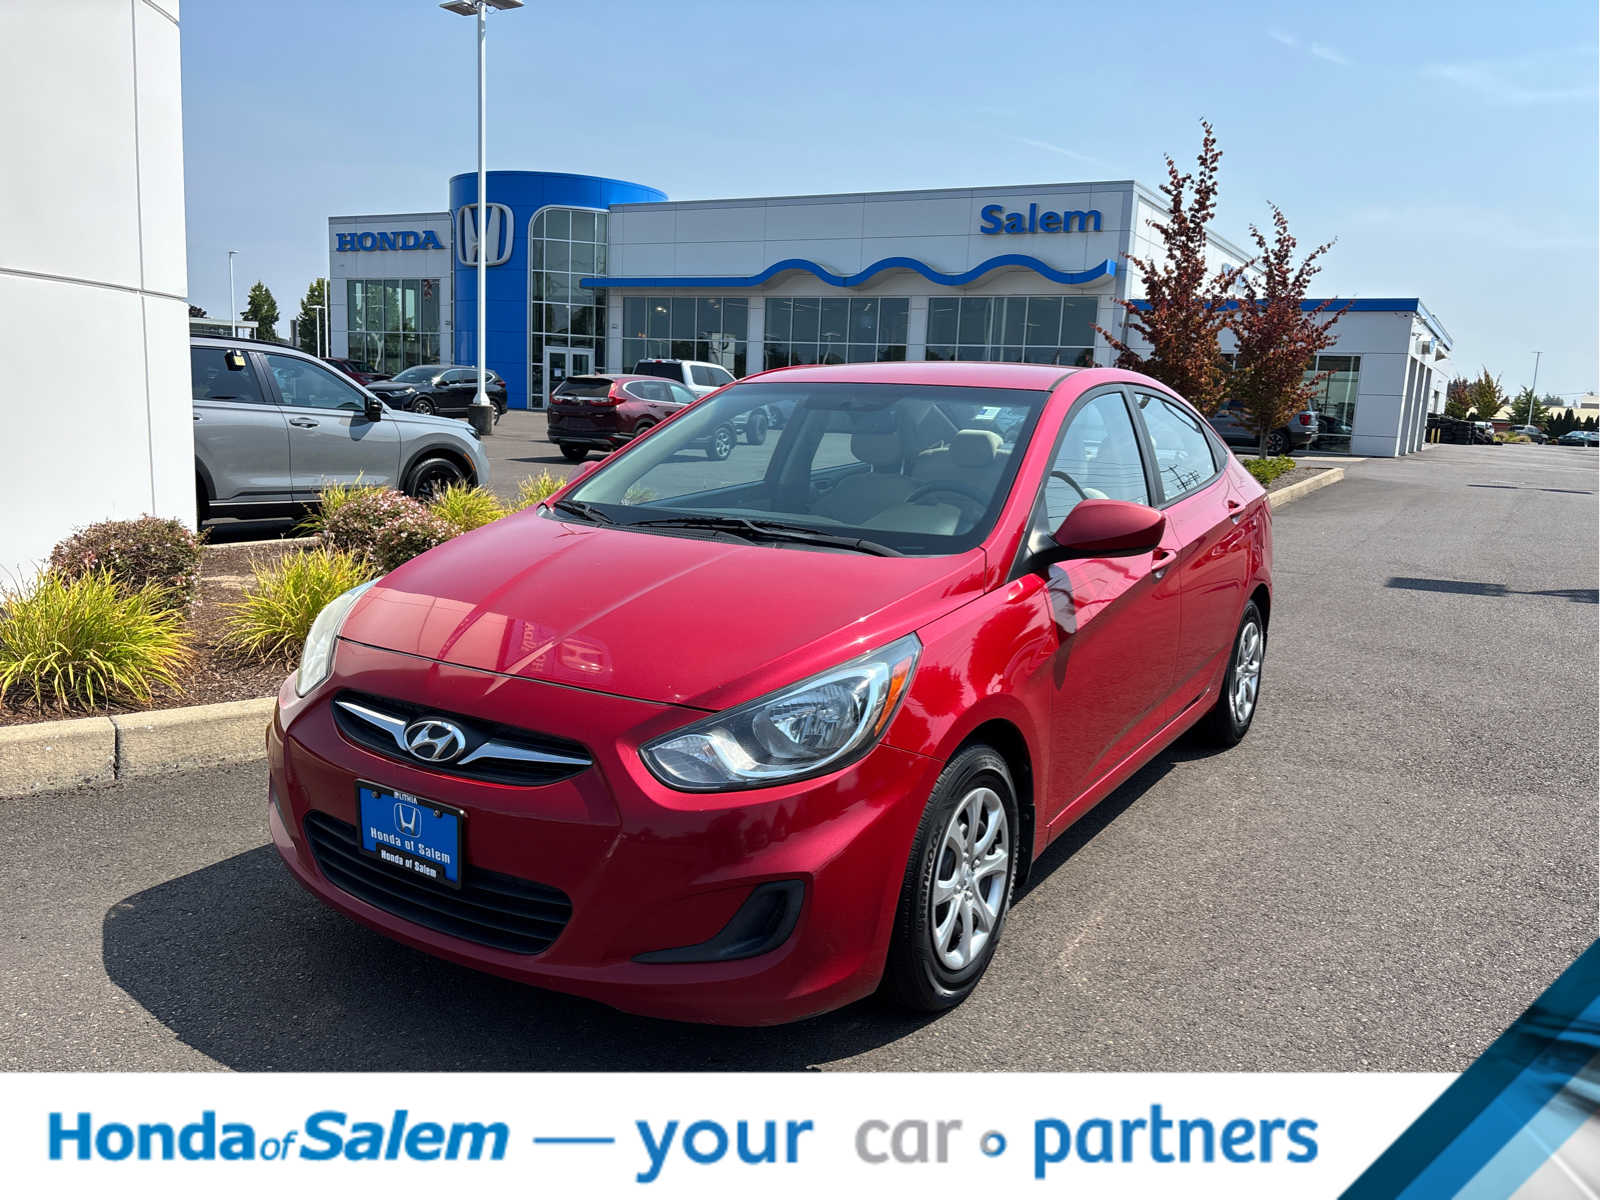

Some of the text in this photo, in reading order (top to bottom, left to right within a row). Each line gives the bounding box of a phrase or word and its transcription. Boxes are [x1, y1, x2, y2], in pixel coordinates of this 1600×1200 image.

[981, 203, 1103, 234] Salem
[336, 230, 446, 251] HONDA
[370, 826, 451, 864] Honda of Salem
[381, 849, 437, 878] Honda of Salem
